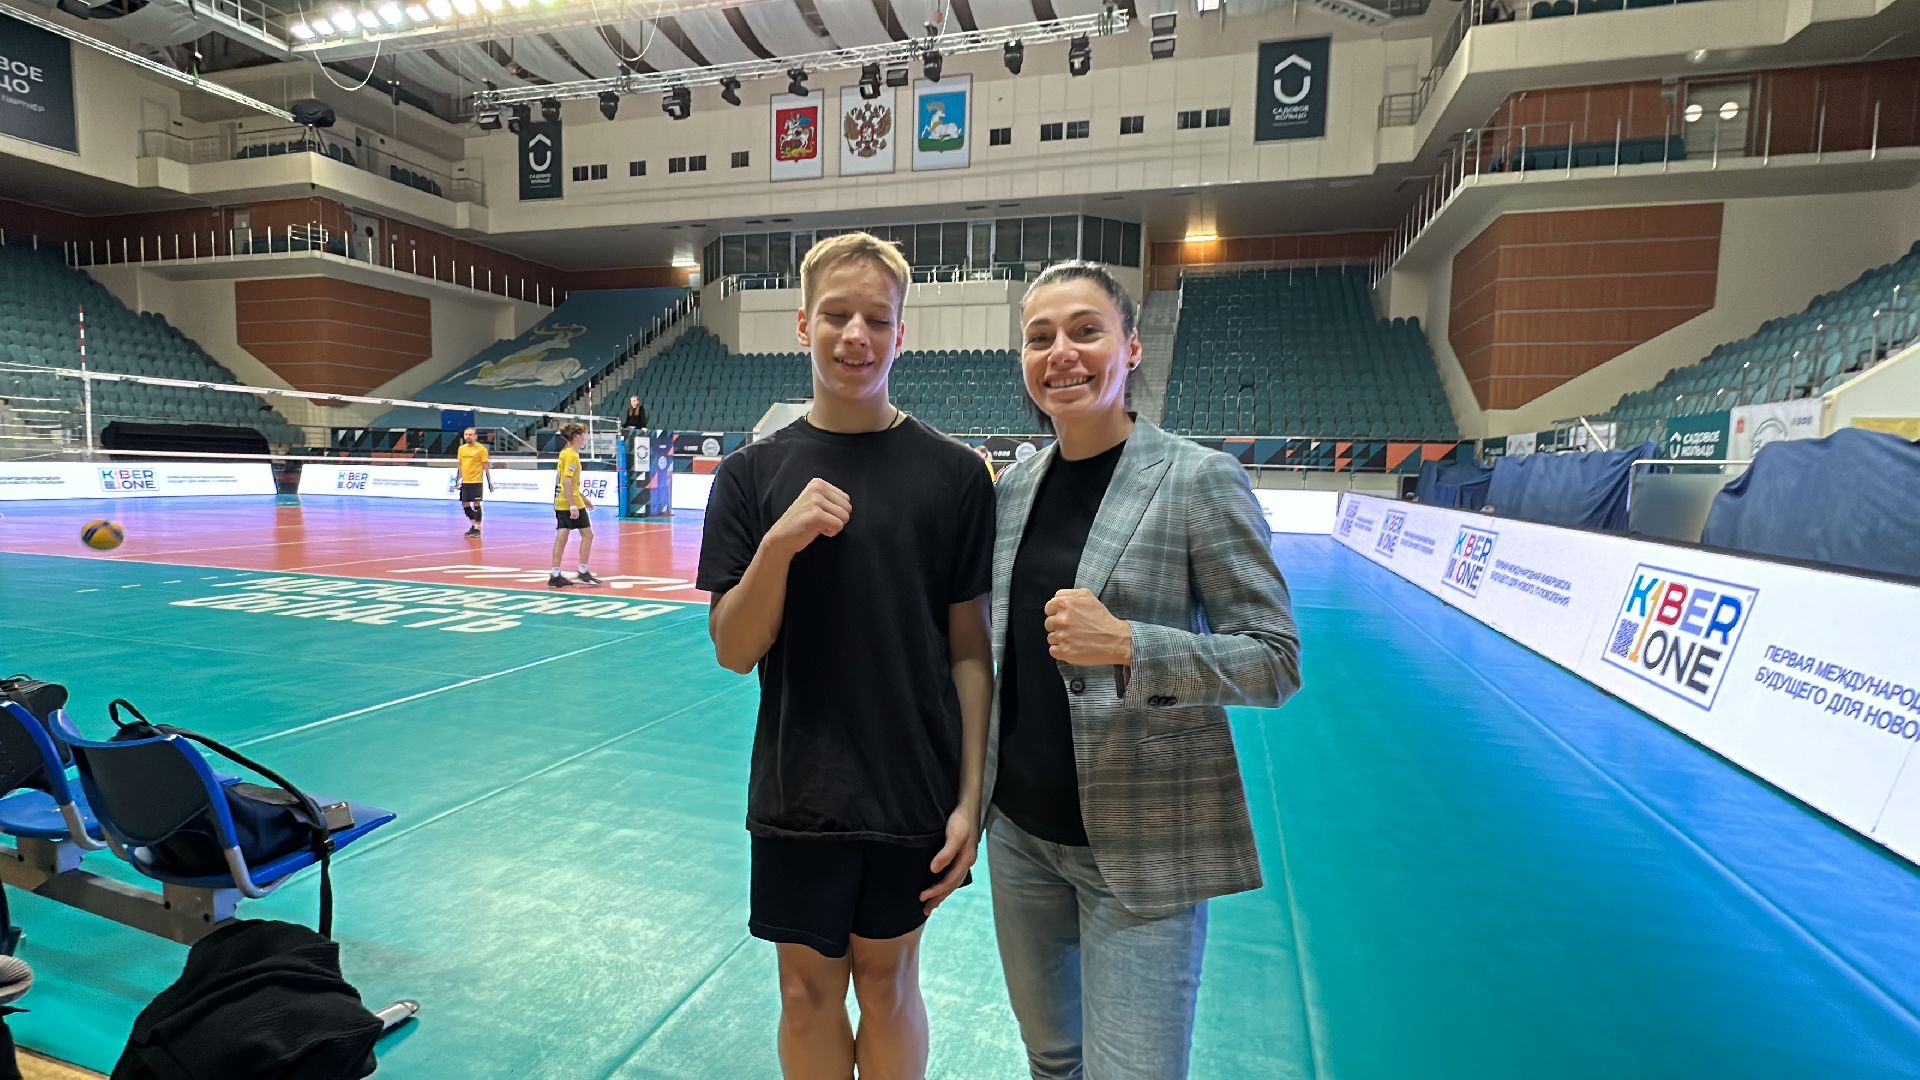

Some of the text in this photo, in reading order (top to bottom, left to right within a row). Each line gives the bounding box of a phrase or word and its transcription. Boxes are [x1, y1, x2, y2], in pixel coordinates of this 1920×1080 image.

[122, 480, 156, 490] ONE
[346, 481, 367, 490] ONE
[582, 489, 606, 499] ONE
[583, 479, 608, 489] BER
[1455, 560, 1484, 591] ONE
[168, 592, 525, 633] ОБЛАСТЬ
[211, 577, 686, 621] МОСКОВСКАЯ
[1643, 629, 1723, 695] ONE
[1764, 644, 1816, 673] ПЕРВАЯ
[1755, 666, 1828, 705] БУДУЩЕГО
[1824, 692, 1865, 719] ДЛЯ
